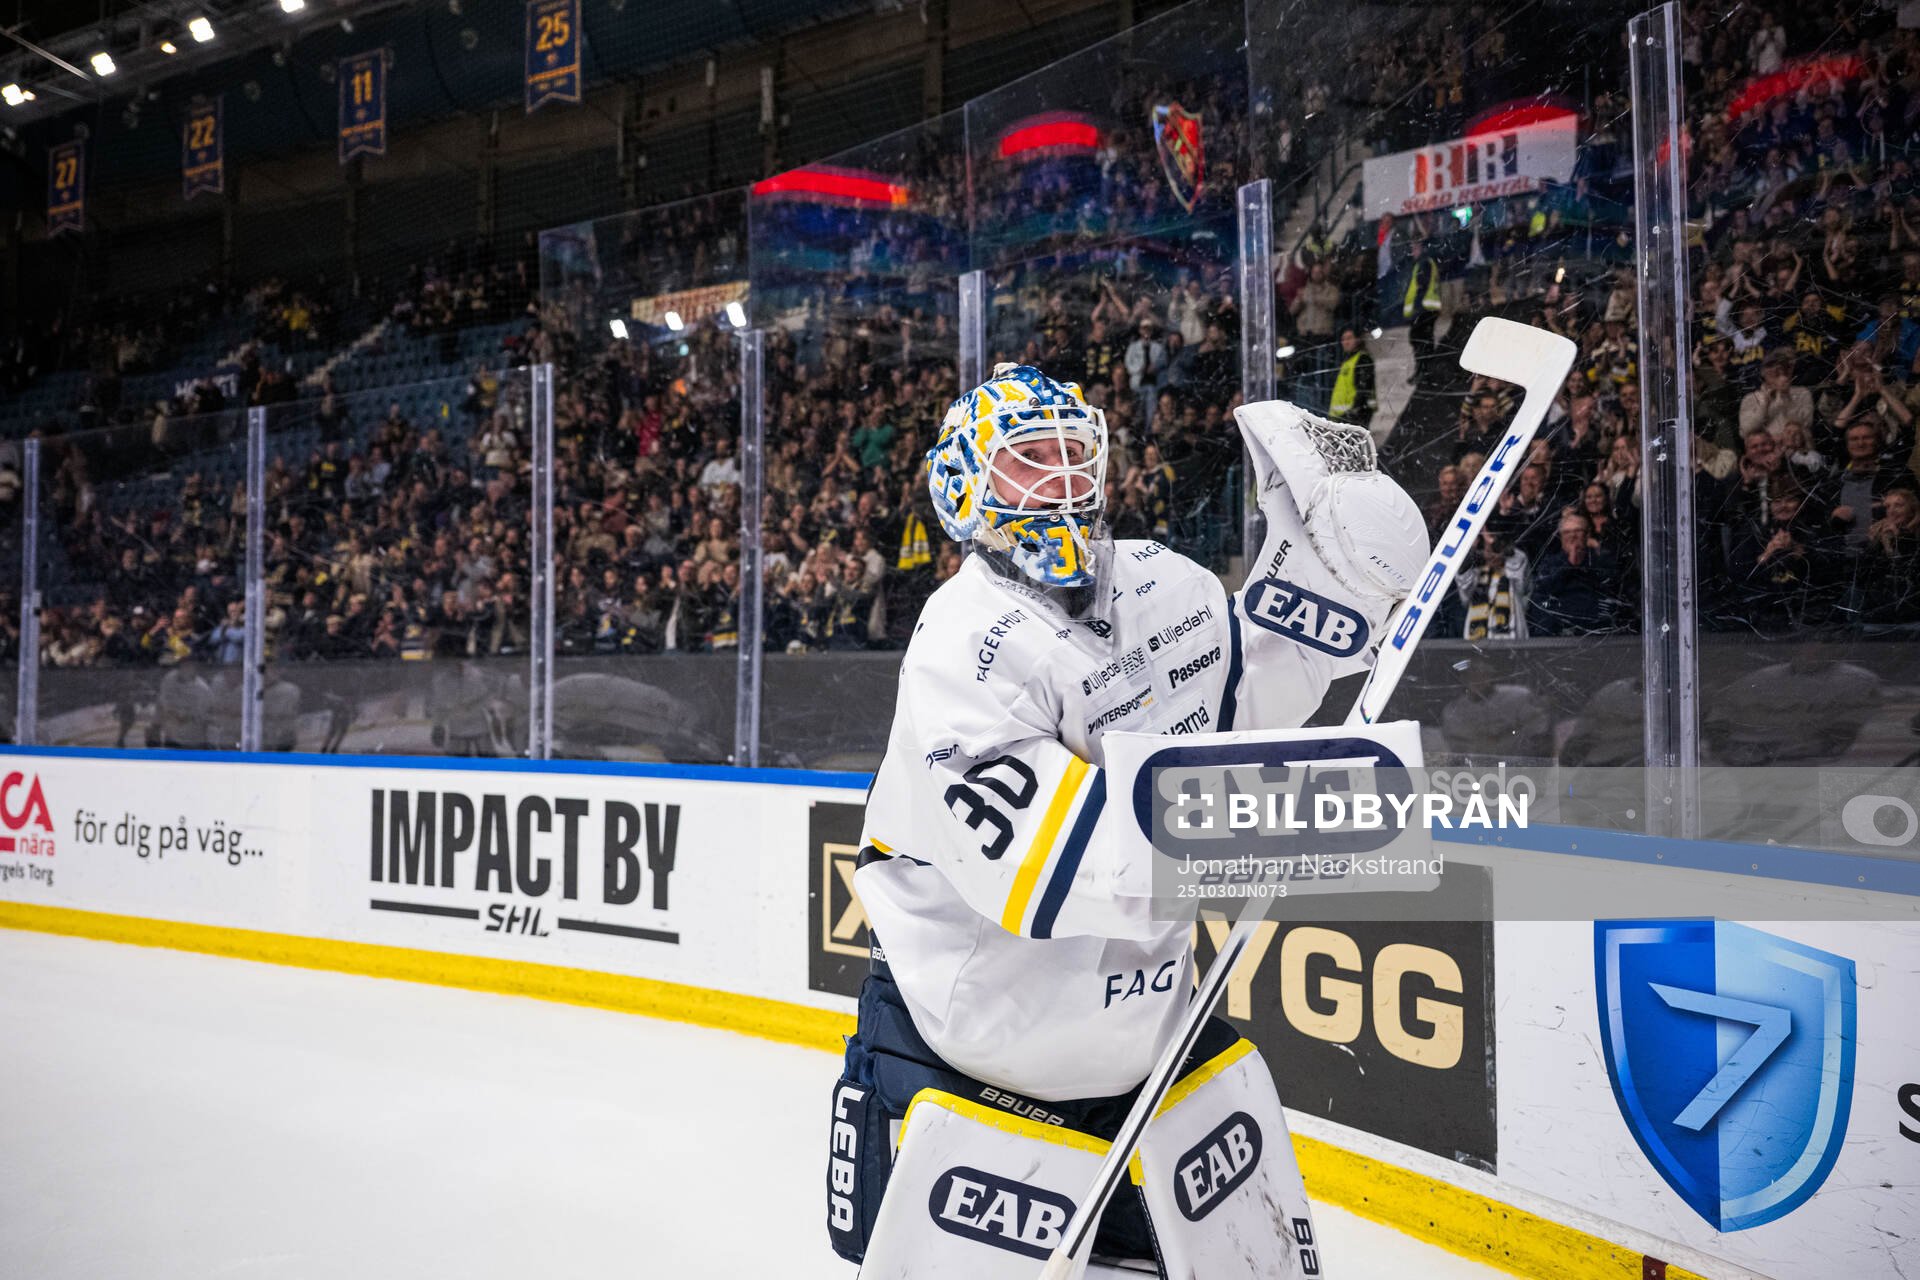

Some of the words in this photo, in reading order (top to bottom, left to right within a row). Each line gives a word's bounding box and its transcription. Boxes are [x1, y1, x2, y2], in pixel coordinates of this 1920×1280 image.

[536, 10, 571, 52] 25
[352, 70, 373, 105] 11
[190, 115, 216, 149] 22
[55, 157, 77, 190] 27
[1135, 582, 1152, 597] FCP
[1158, 605, 1213, 644] Liljedahl
[1252, 583, 1358, 650] EAB
[1167, 646, 1222, 690] Passera
[1095, 699, 1141, 730] INTERSPO
[1160, 706, 1210, 735] varna
[944, 755, 1039, 861] 30
[1157, 756, 1388, 840] EAB
[19, 834, 55, 856] nära
[74, 809, 108, 844] för
[115, 812, 151, 858] dig
[159, 816, 188, 859] på
[197, 820, 264, 866] väg...
[371, 789, 590, 898] IMPACT
[603, 799, 682, 911] BY
[28, 863, 54, 888] Torg
[484, 903, 551, 938] SHL
[1104, 954, 1185, 1010] FAG
[1191, 908, 1464, 1070] YGG
[831, 1085, 866, 1233] LEBA
[1179, 1123, 1254, 1214] EAB
[939, 1175, 1067, 1251] EAB
